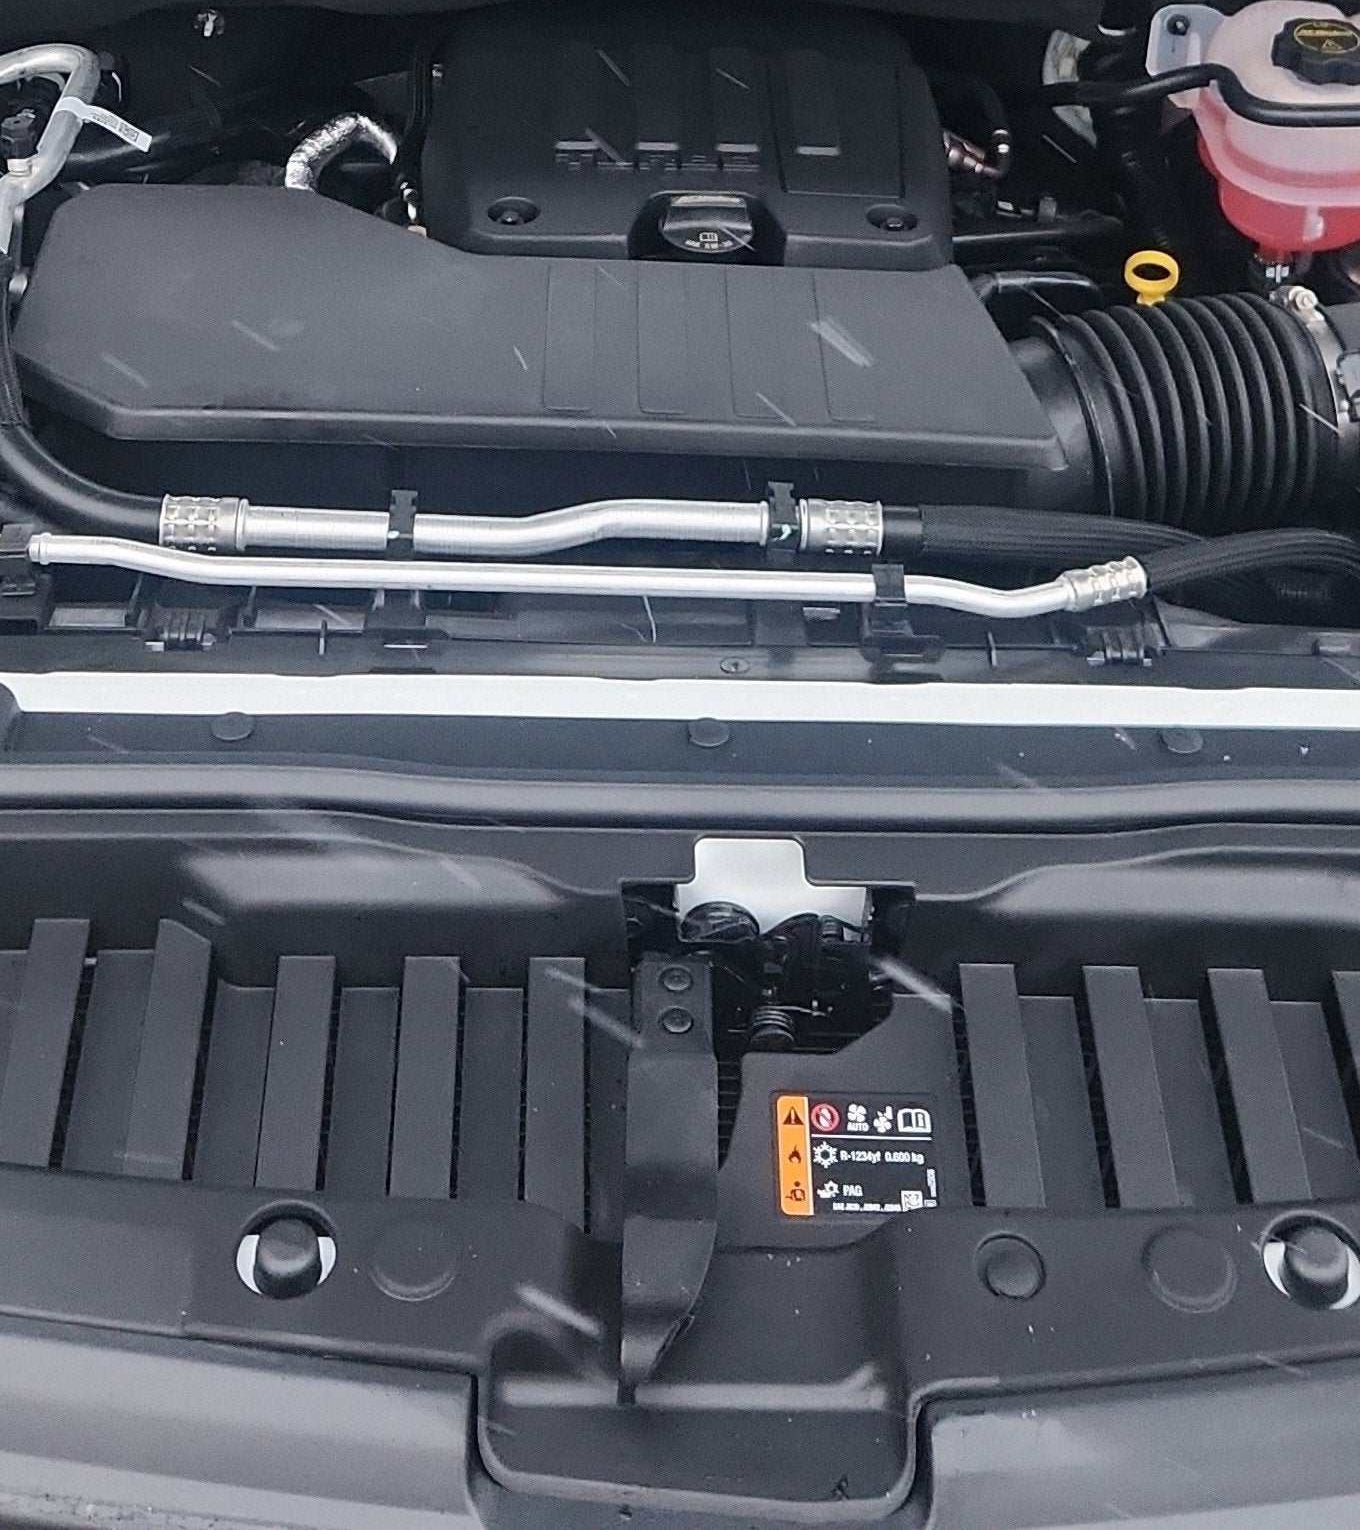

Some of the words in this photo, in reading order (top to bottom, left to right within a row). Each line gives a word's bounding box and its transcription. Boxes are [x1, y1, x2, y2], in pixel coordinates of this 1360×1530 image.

[846, 1122, 870, 1132] AUTO
[840, 1150, 881, 1164] R-1234yf
[911, 1151, 925, 1165] kg
[842, 1184, 863, 1197] PAG
